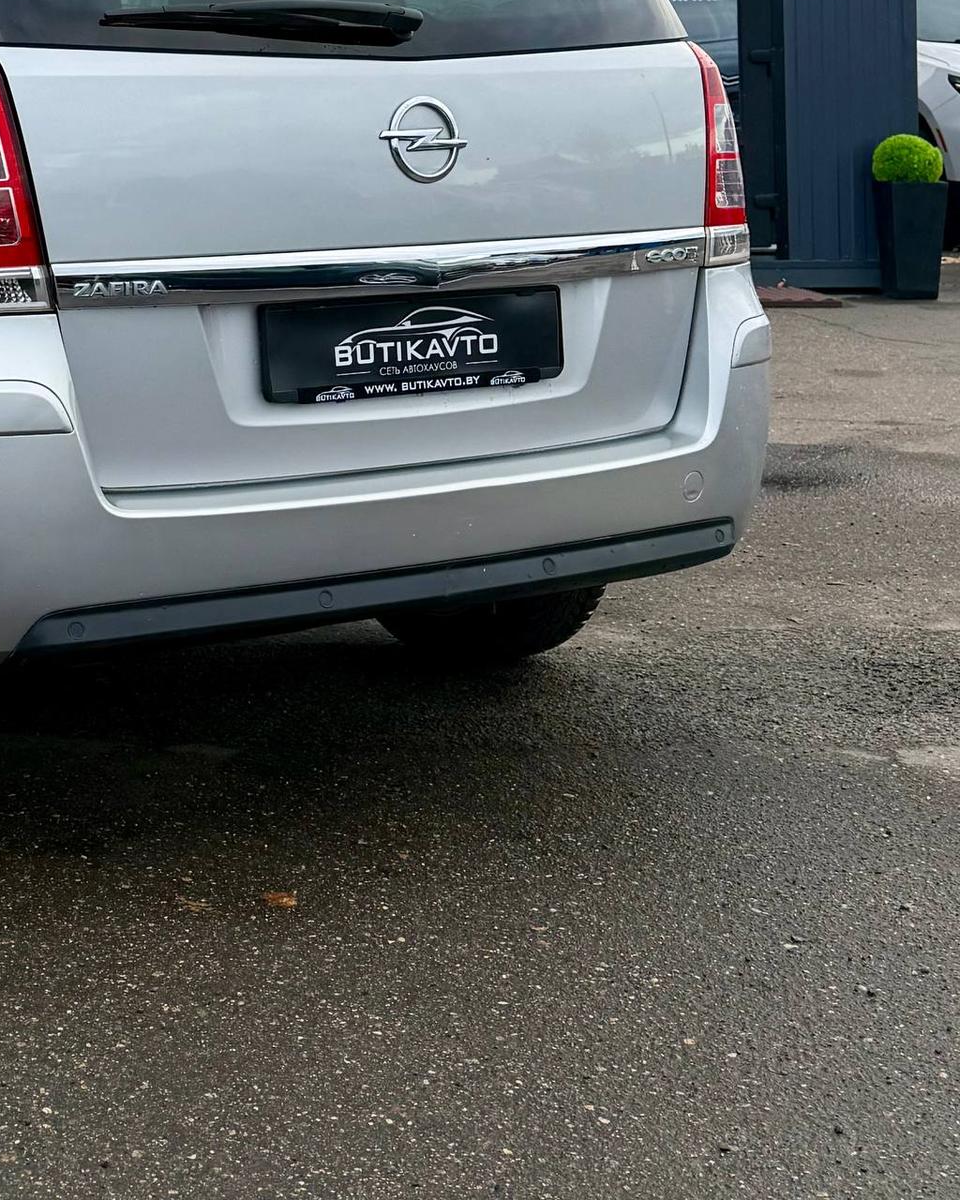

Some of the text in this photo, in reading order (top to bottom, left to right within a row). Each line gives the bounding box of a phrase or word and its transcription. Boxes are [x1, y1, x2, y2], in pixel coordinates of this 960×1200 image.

[73, 279, 169, 298] ZAFIRA
[334, 333, 498, 367] BUTIKAVTO
[379, 360, 458, 377] СЕТЬ АВТОХАУСОВ
[364, 375, 481, 395] WWW. BUTIKAVTO.BY
[490, 375, 526, 386] BUTIKAVTO
[315, 392, 355, 402] BUTIKAVTO
